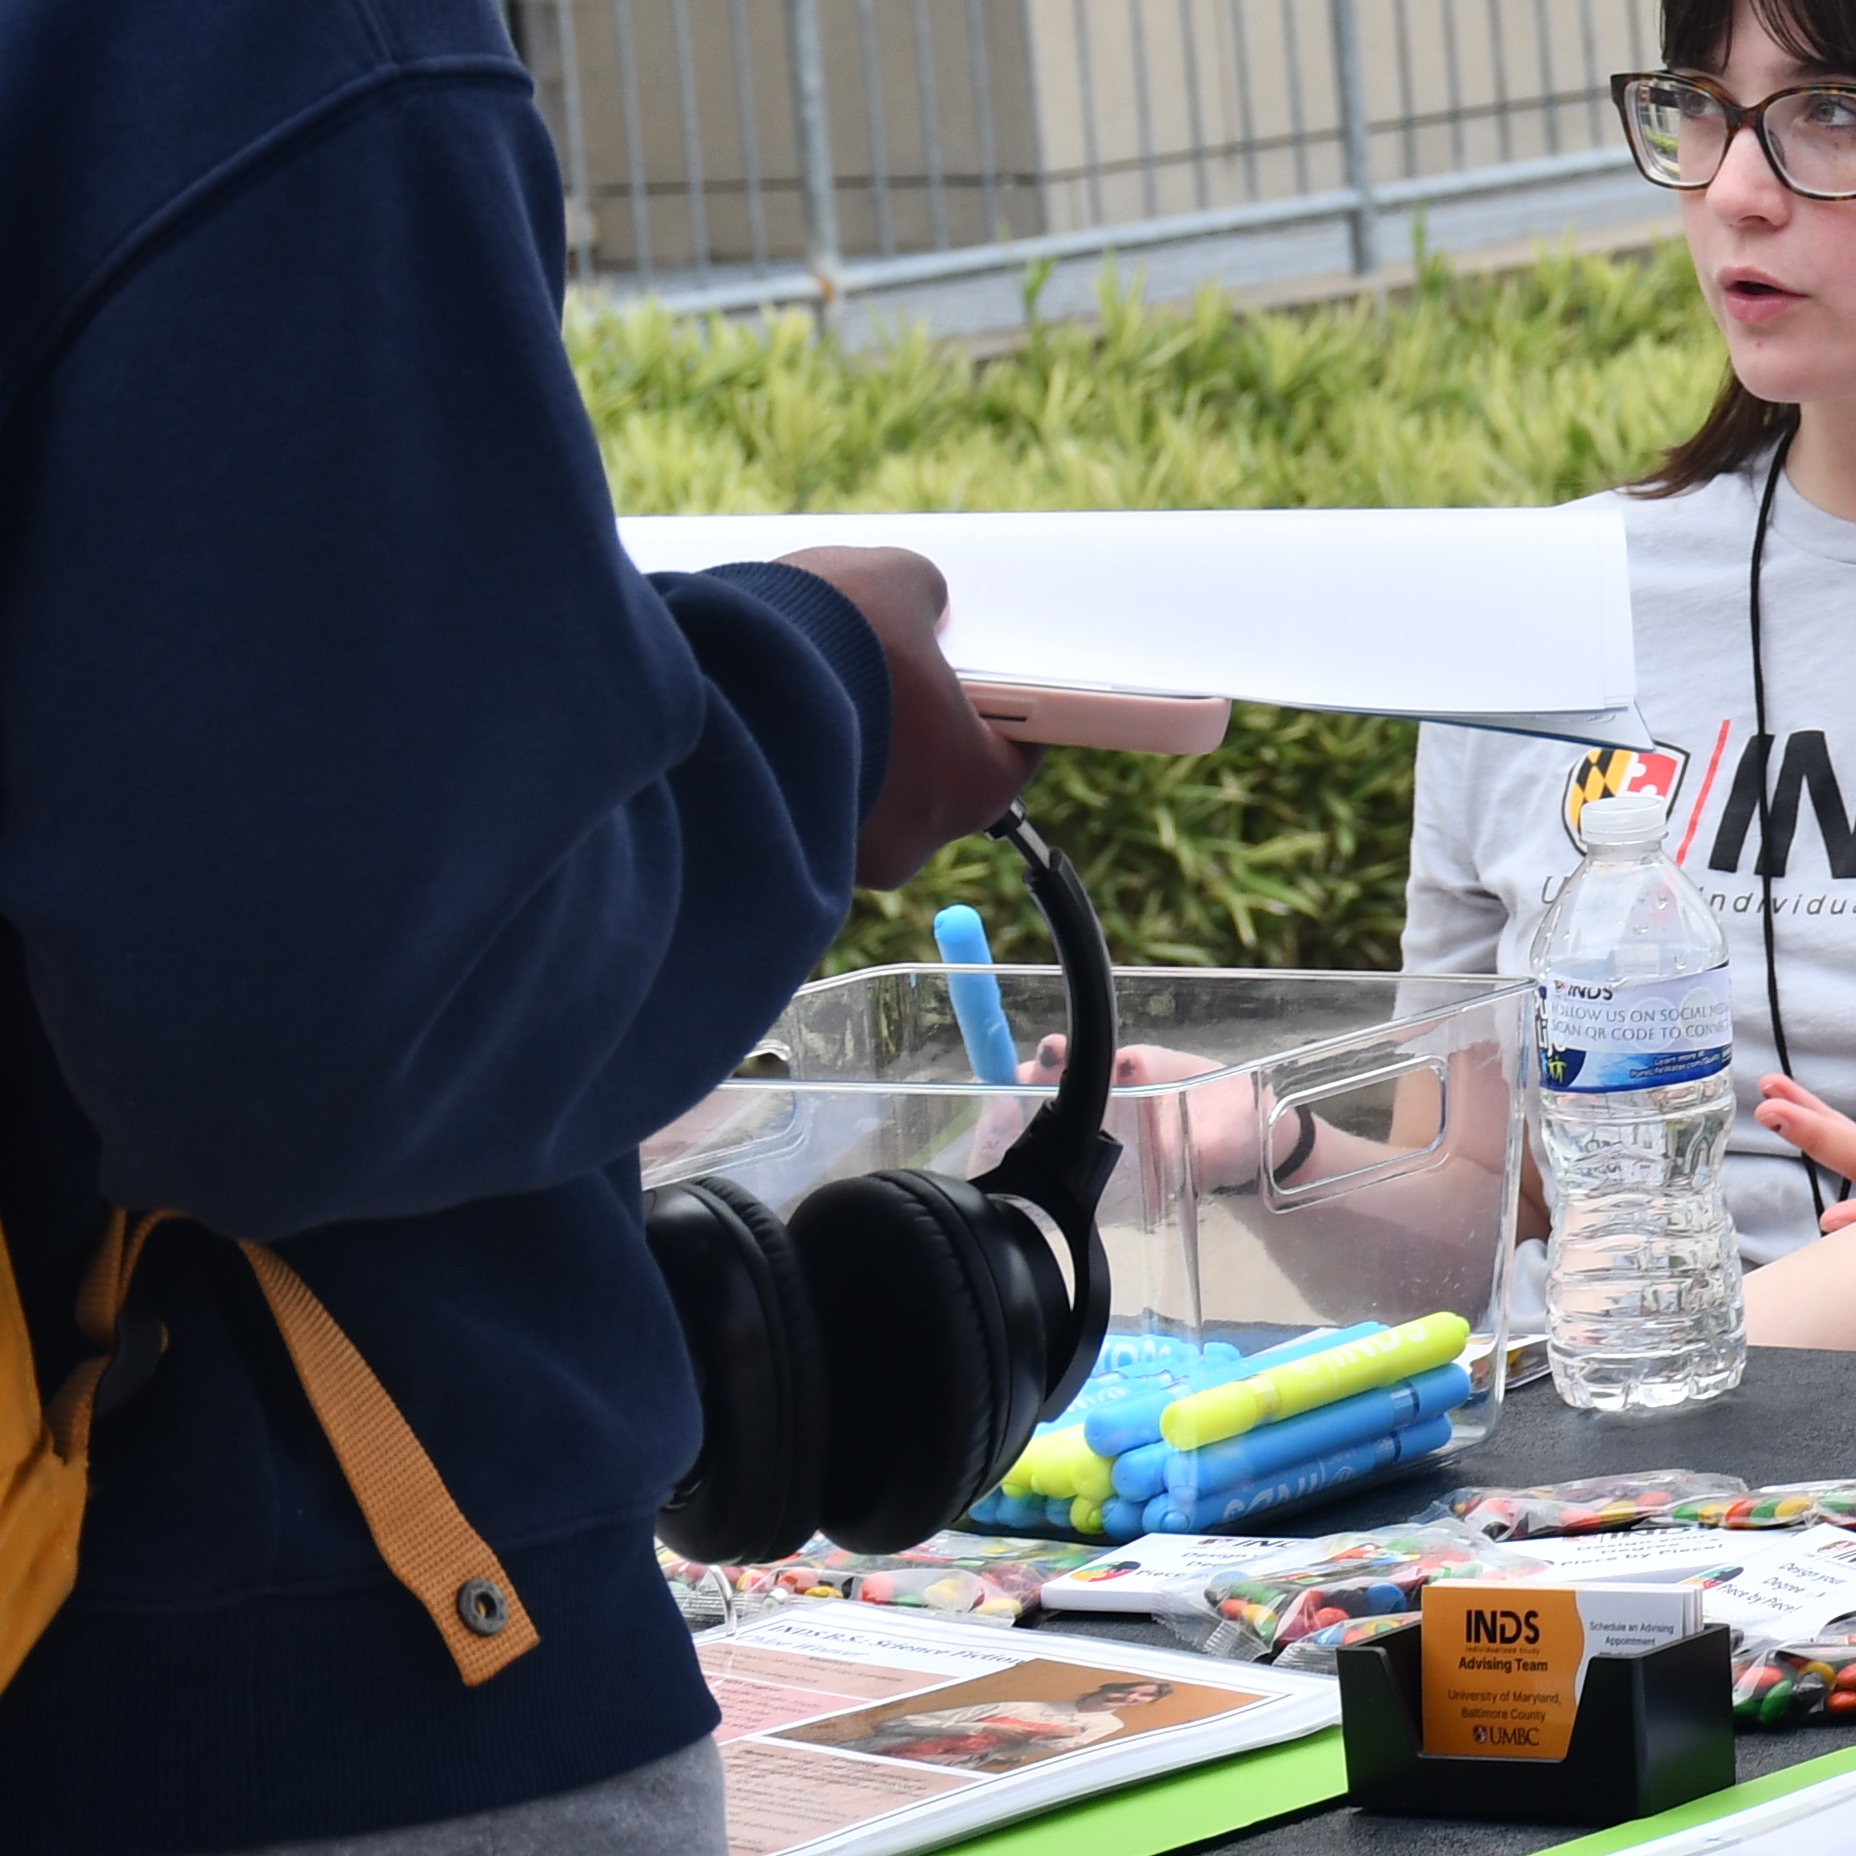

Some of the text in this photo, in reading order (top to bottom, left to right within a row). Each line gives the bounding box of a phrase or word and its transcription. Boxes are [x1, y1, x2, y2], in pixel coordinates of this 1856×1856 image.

[1551, 1002, 1601, 1022] FOLLOW
[1606, 1009, 1625, 1023] US
[1630, 1009, 1655, 1022] ON
[1660, 1006, 1707, 1022] SOCIAL
[1551, 1019, 1581, 1037] SCAN
[1585, 1026, 1607, 1042] QR
[1611, 1026, 1655, 1041] CODE
[1660, 1026, 1682, 1040] TO
[1465, 1609, 1540, 1644] INDS
[1588, 1621, 1675, 1636] Schedule an Advising
[1604, 1635, 1656, 1648] Appointment
[1458, 1657, 1549, 1674] Advising Team
[1447, 1689, 1562, 1706] University of Maryland,
[1461, 1707, 1546, 1722] Baltimore County
[1489, 1727, 1540, 1746] UMBC
